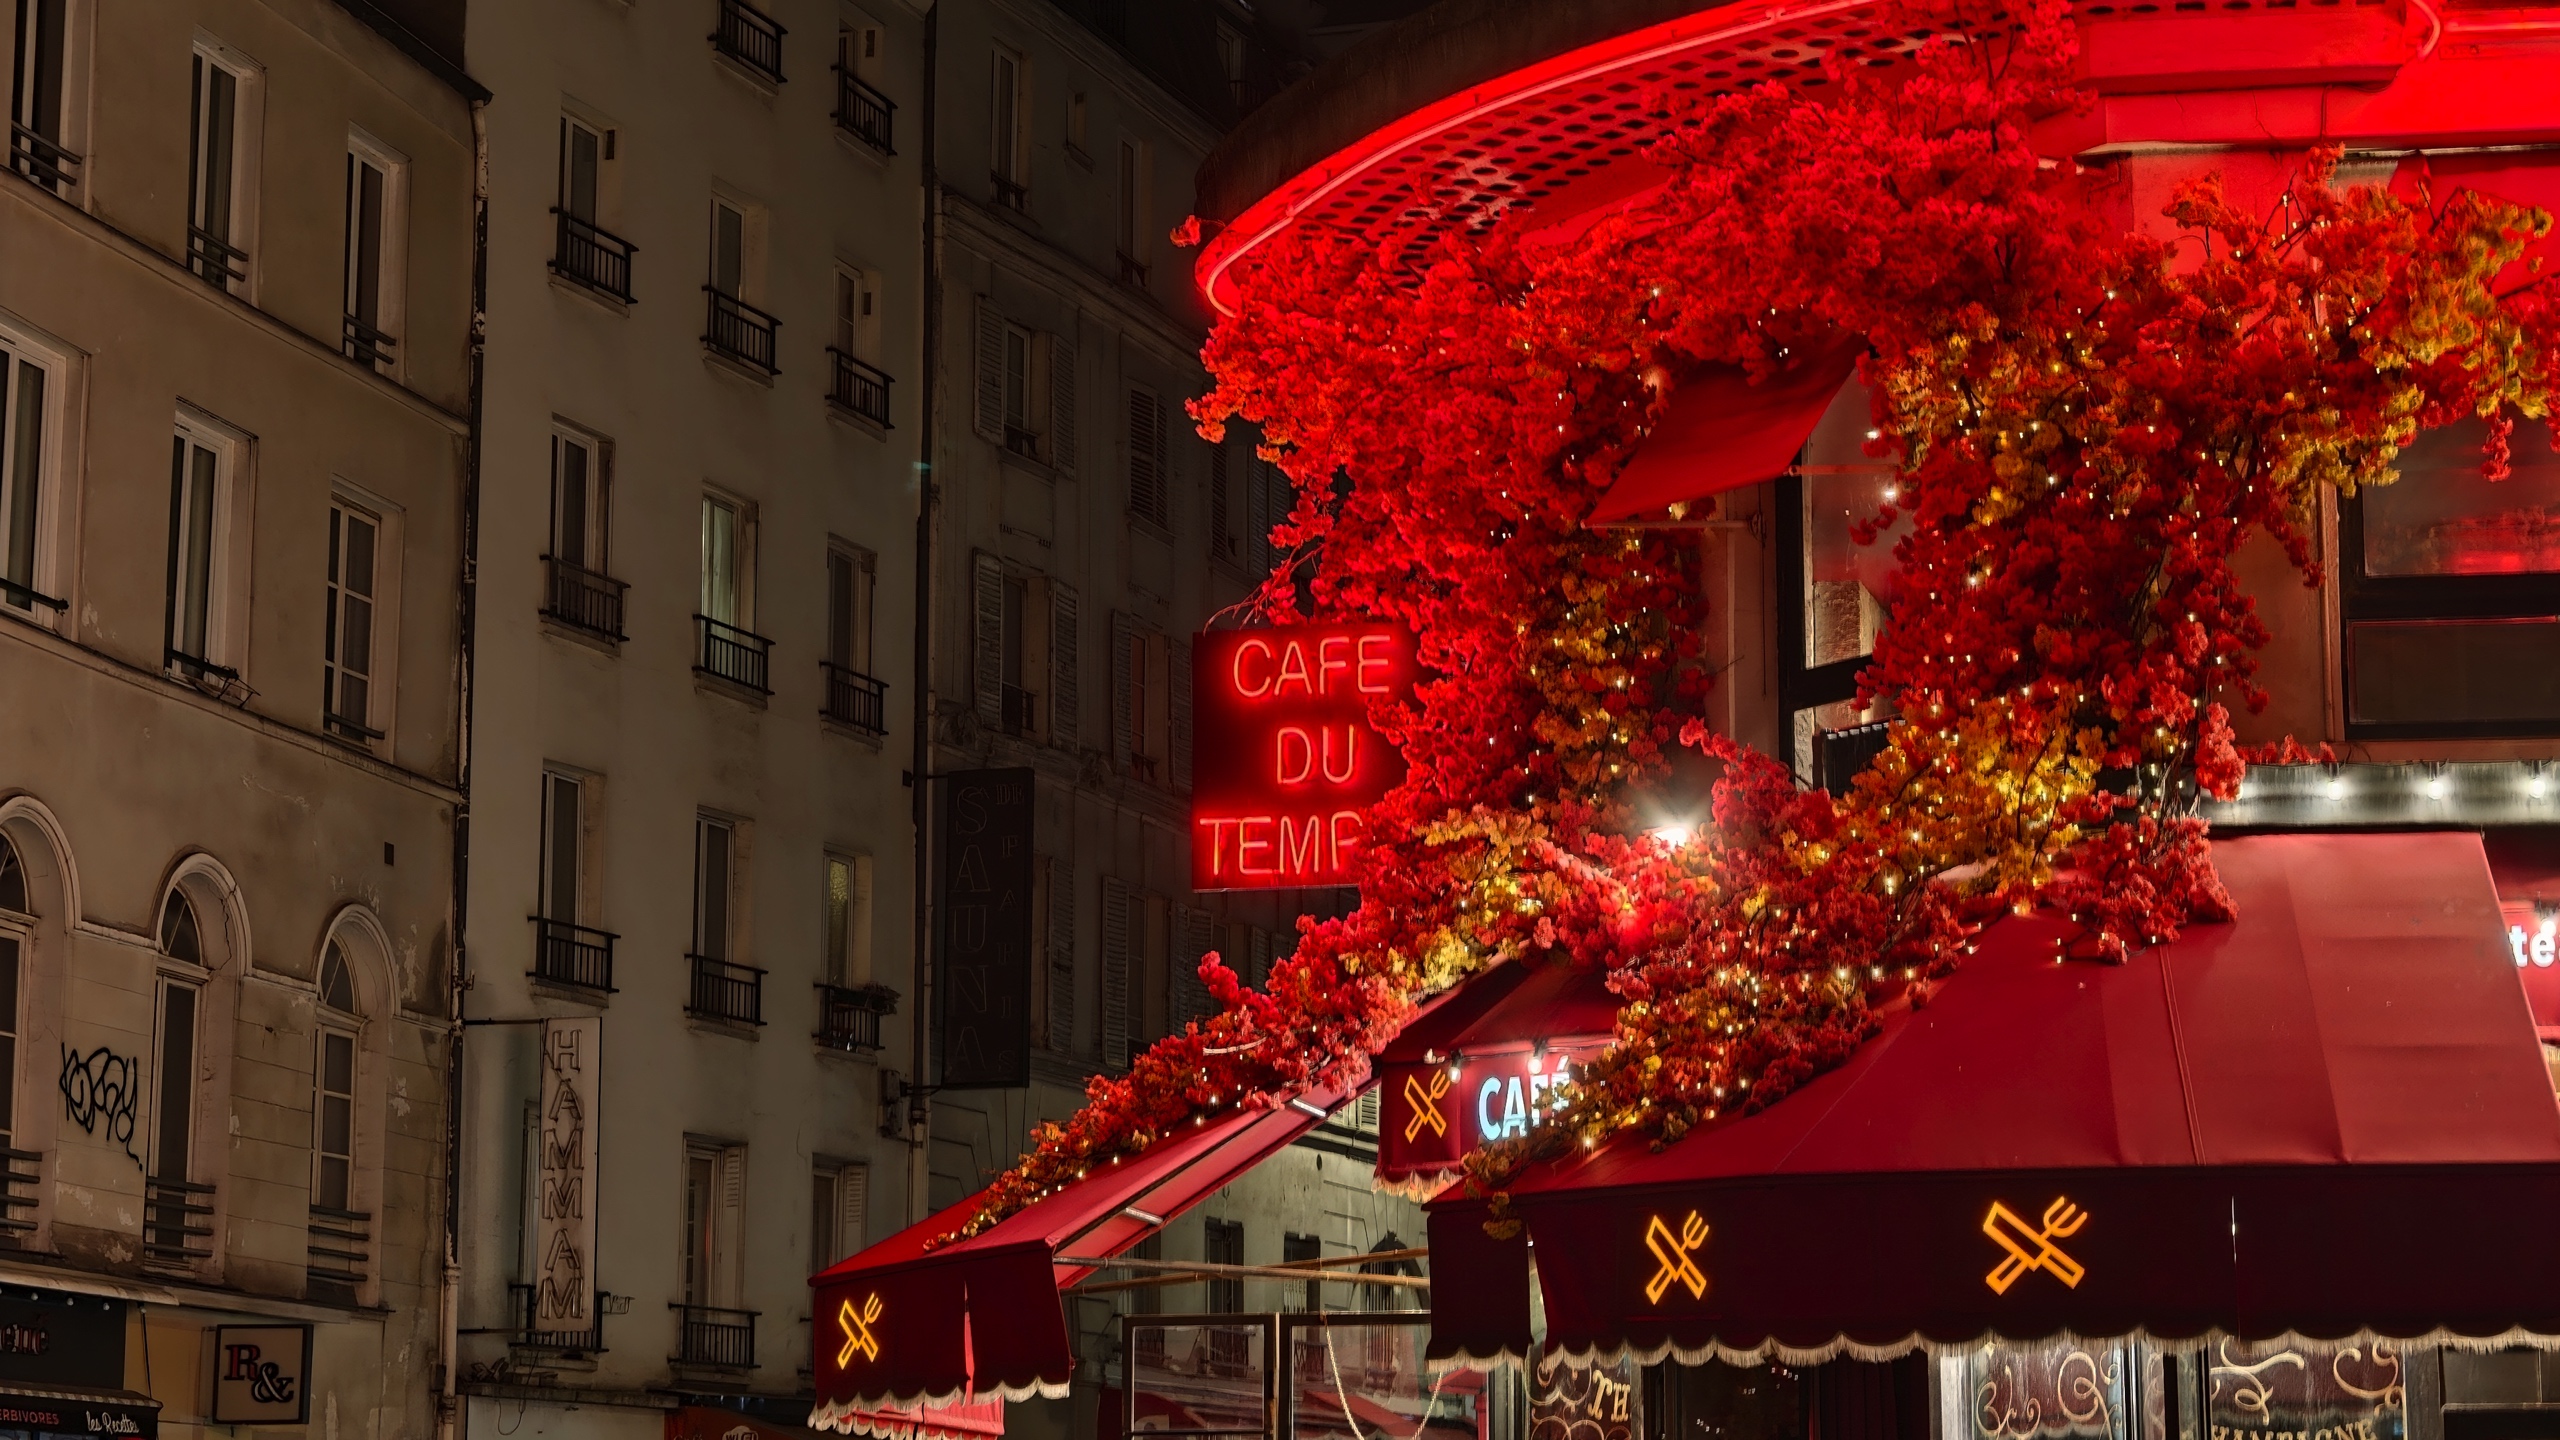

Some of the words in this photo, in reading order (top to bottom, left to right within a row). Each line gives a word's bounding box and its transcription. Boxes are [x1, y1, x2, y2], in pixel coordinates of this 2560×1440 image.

[1233, 634, 1391, 698] CAFE
[1276, 724, 1355, 785] DU
[1199, 810, 1363, 876] TEMP
[950, 786, 990, 1072] SAUNA
[541, 1028, 585, 1320] HAMMAM
